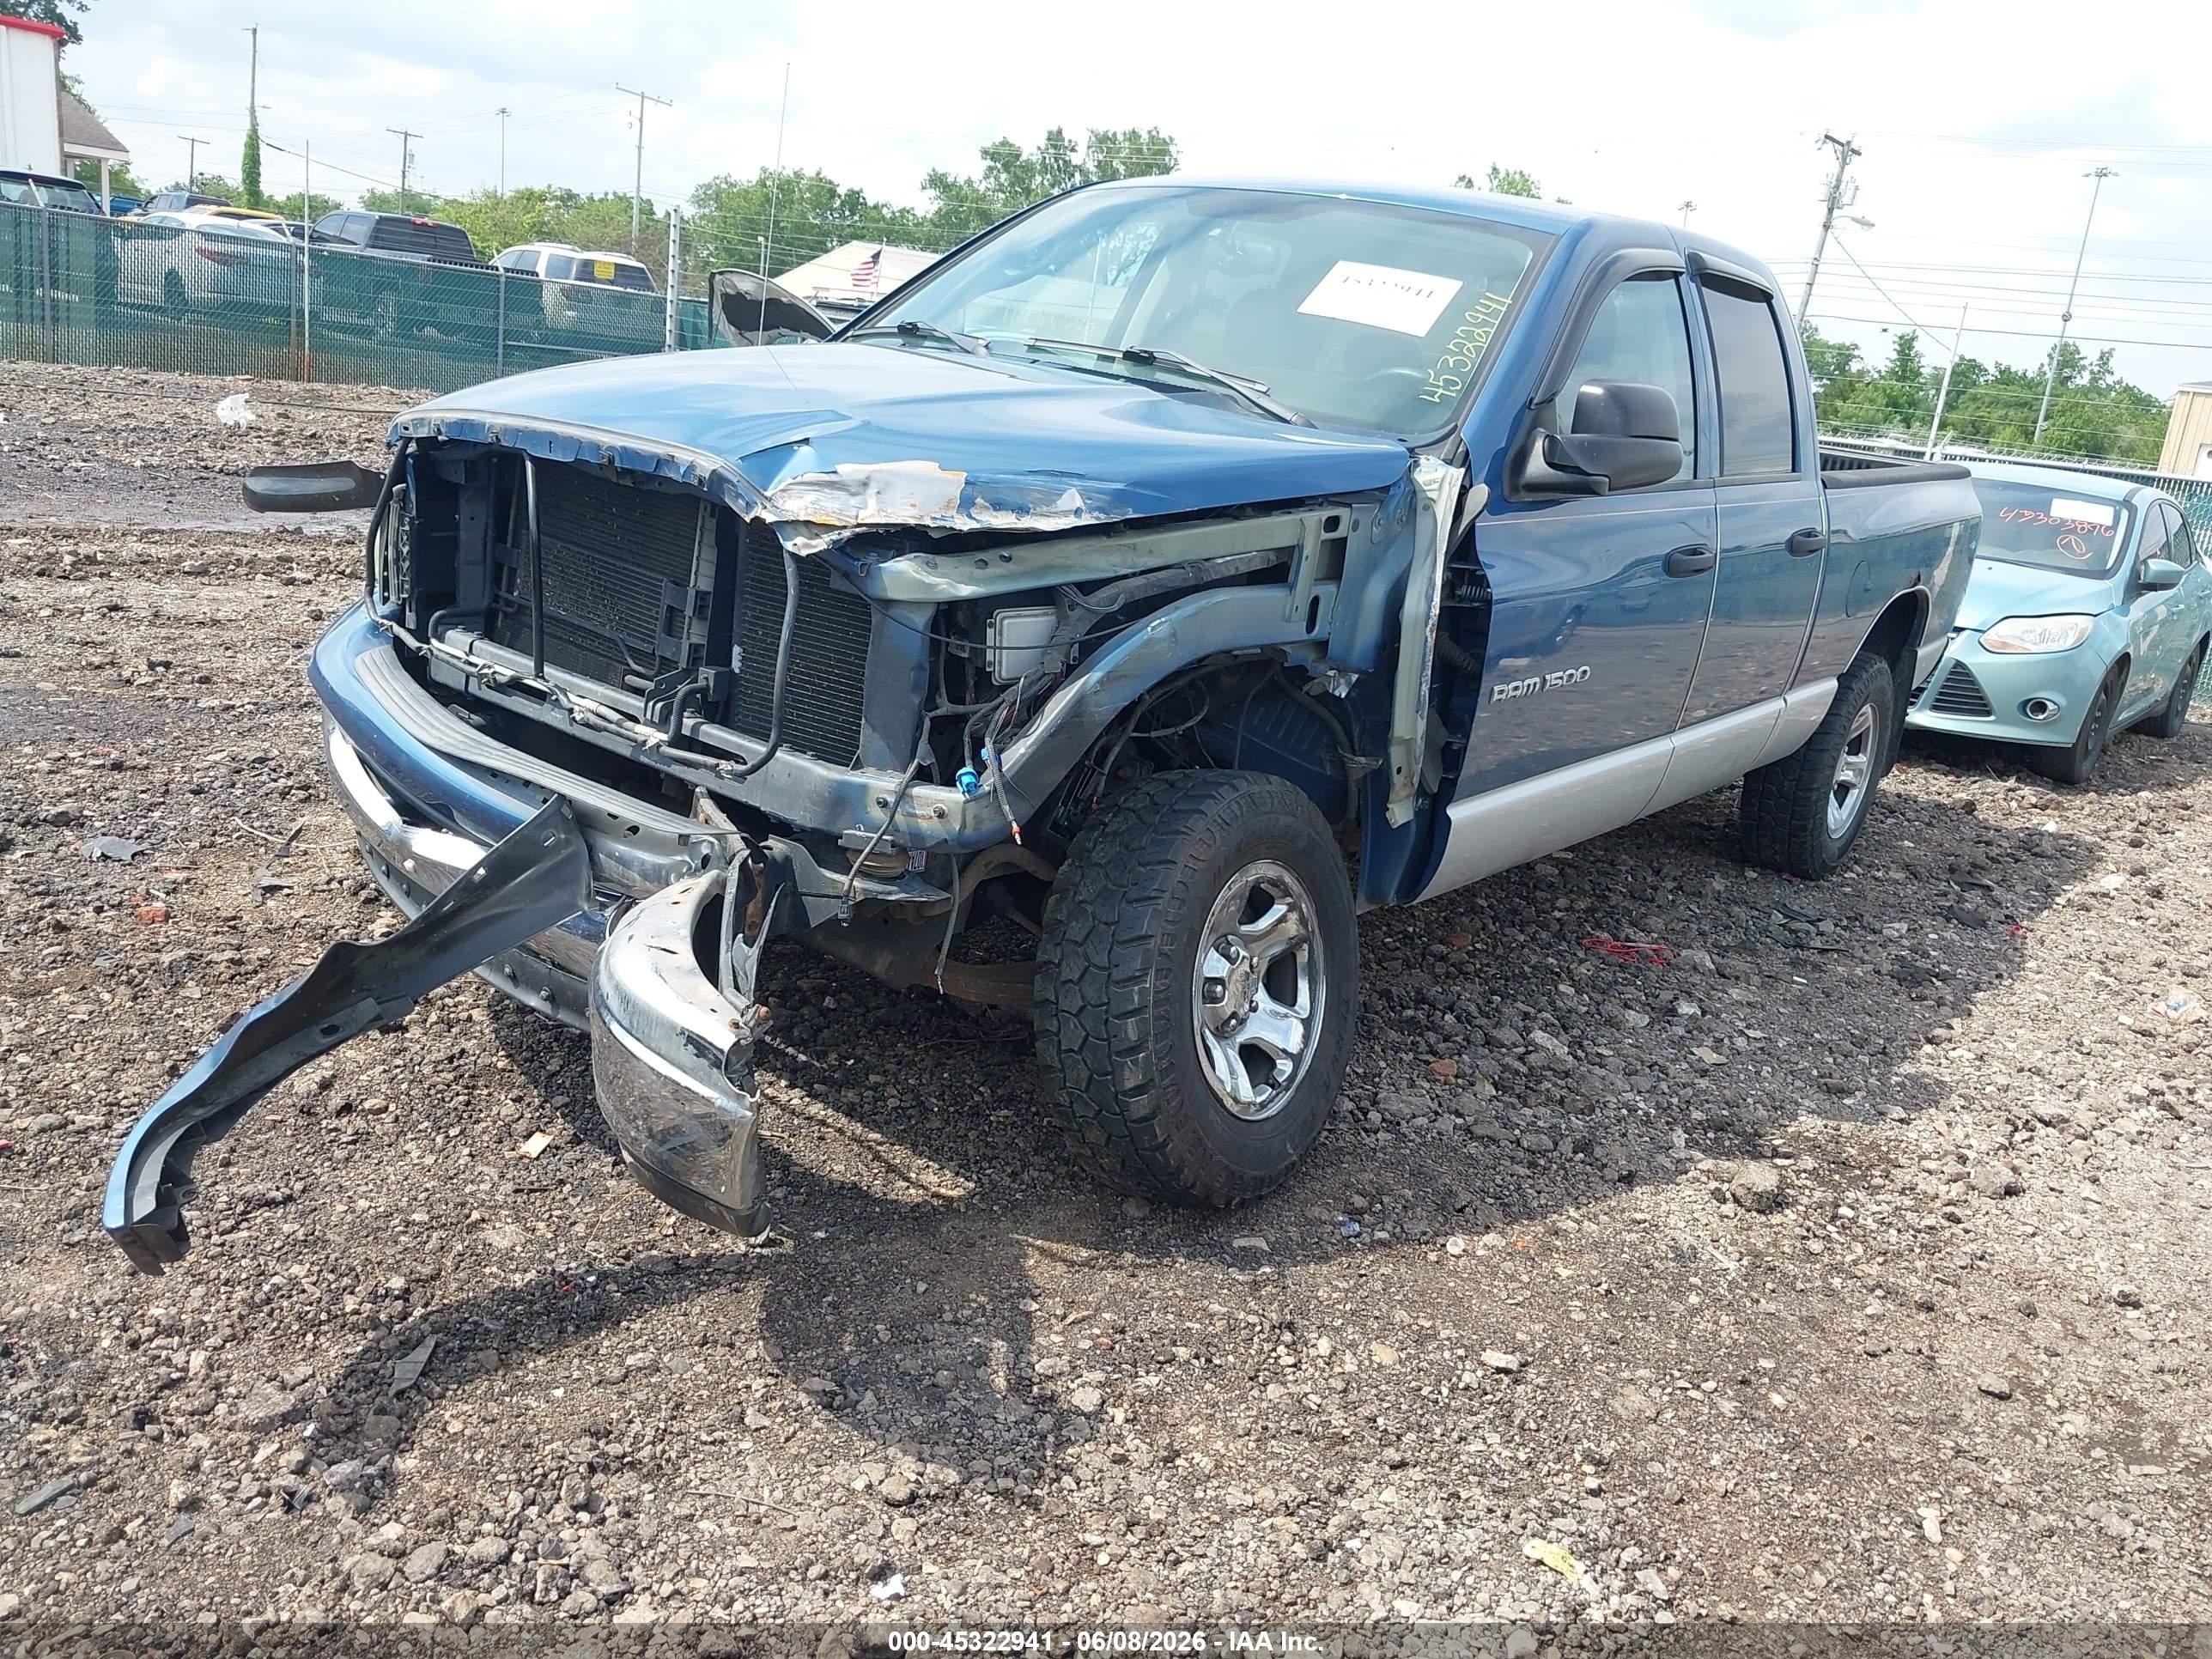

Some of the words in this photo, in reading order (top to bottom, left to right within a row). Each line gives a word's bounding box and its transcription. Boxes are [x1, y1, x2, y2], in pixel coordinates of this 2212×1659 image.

[1419, 292, 1512, 403] 45322941
[1489, 677, 1540, 703] RAM
[1543, 665, 1590, 692] 1500
